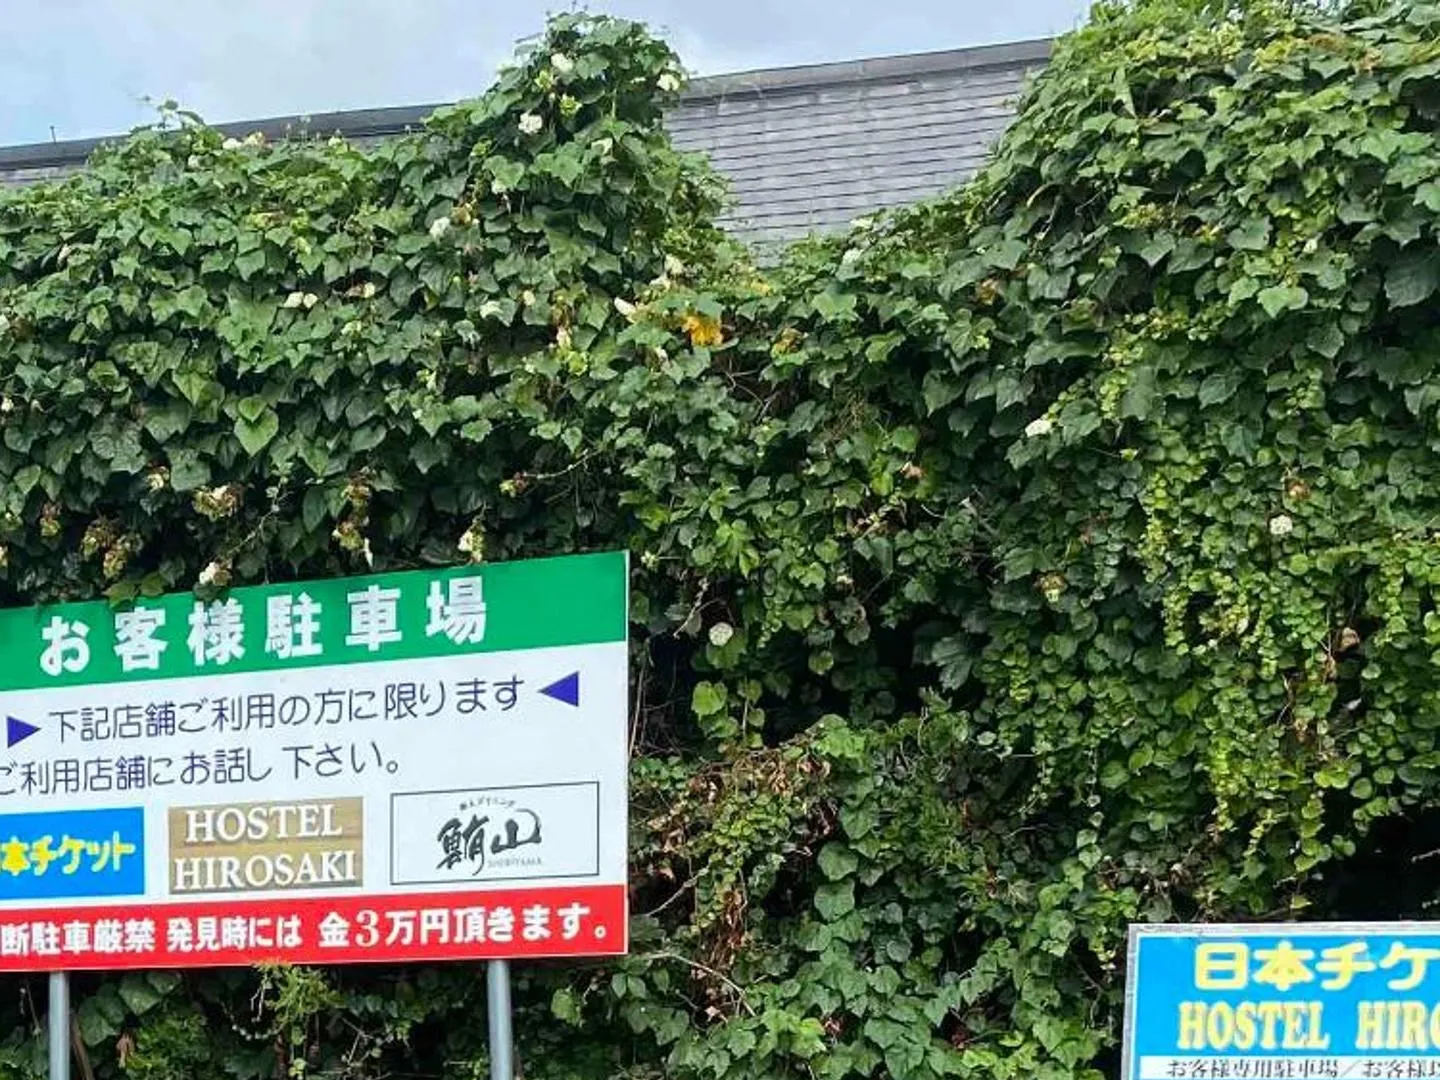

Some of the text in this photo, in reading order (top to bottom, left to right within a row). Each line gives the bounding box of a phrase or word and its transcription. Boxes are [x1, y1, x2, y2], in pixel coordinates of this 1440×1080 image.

[39, 575, 488, 677] お客様駐車場
[48, 674, 525, 743] 下記店舗ご利用の方に限ります
[184, 802, 344, 843] HOSTEL
[173, 850, 356, 891] HIROSAKI
[166, 914, 302, 953] 発見時には
[1176, 1001, 1330, 1050] HOSTEL
